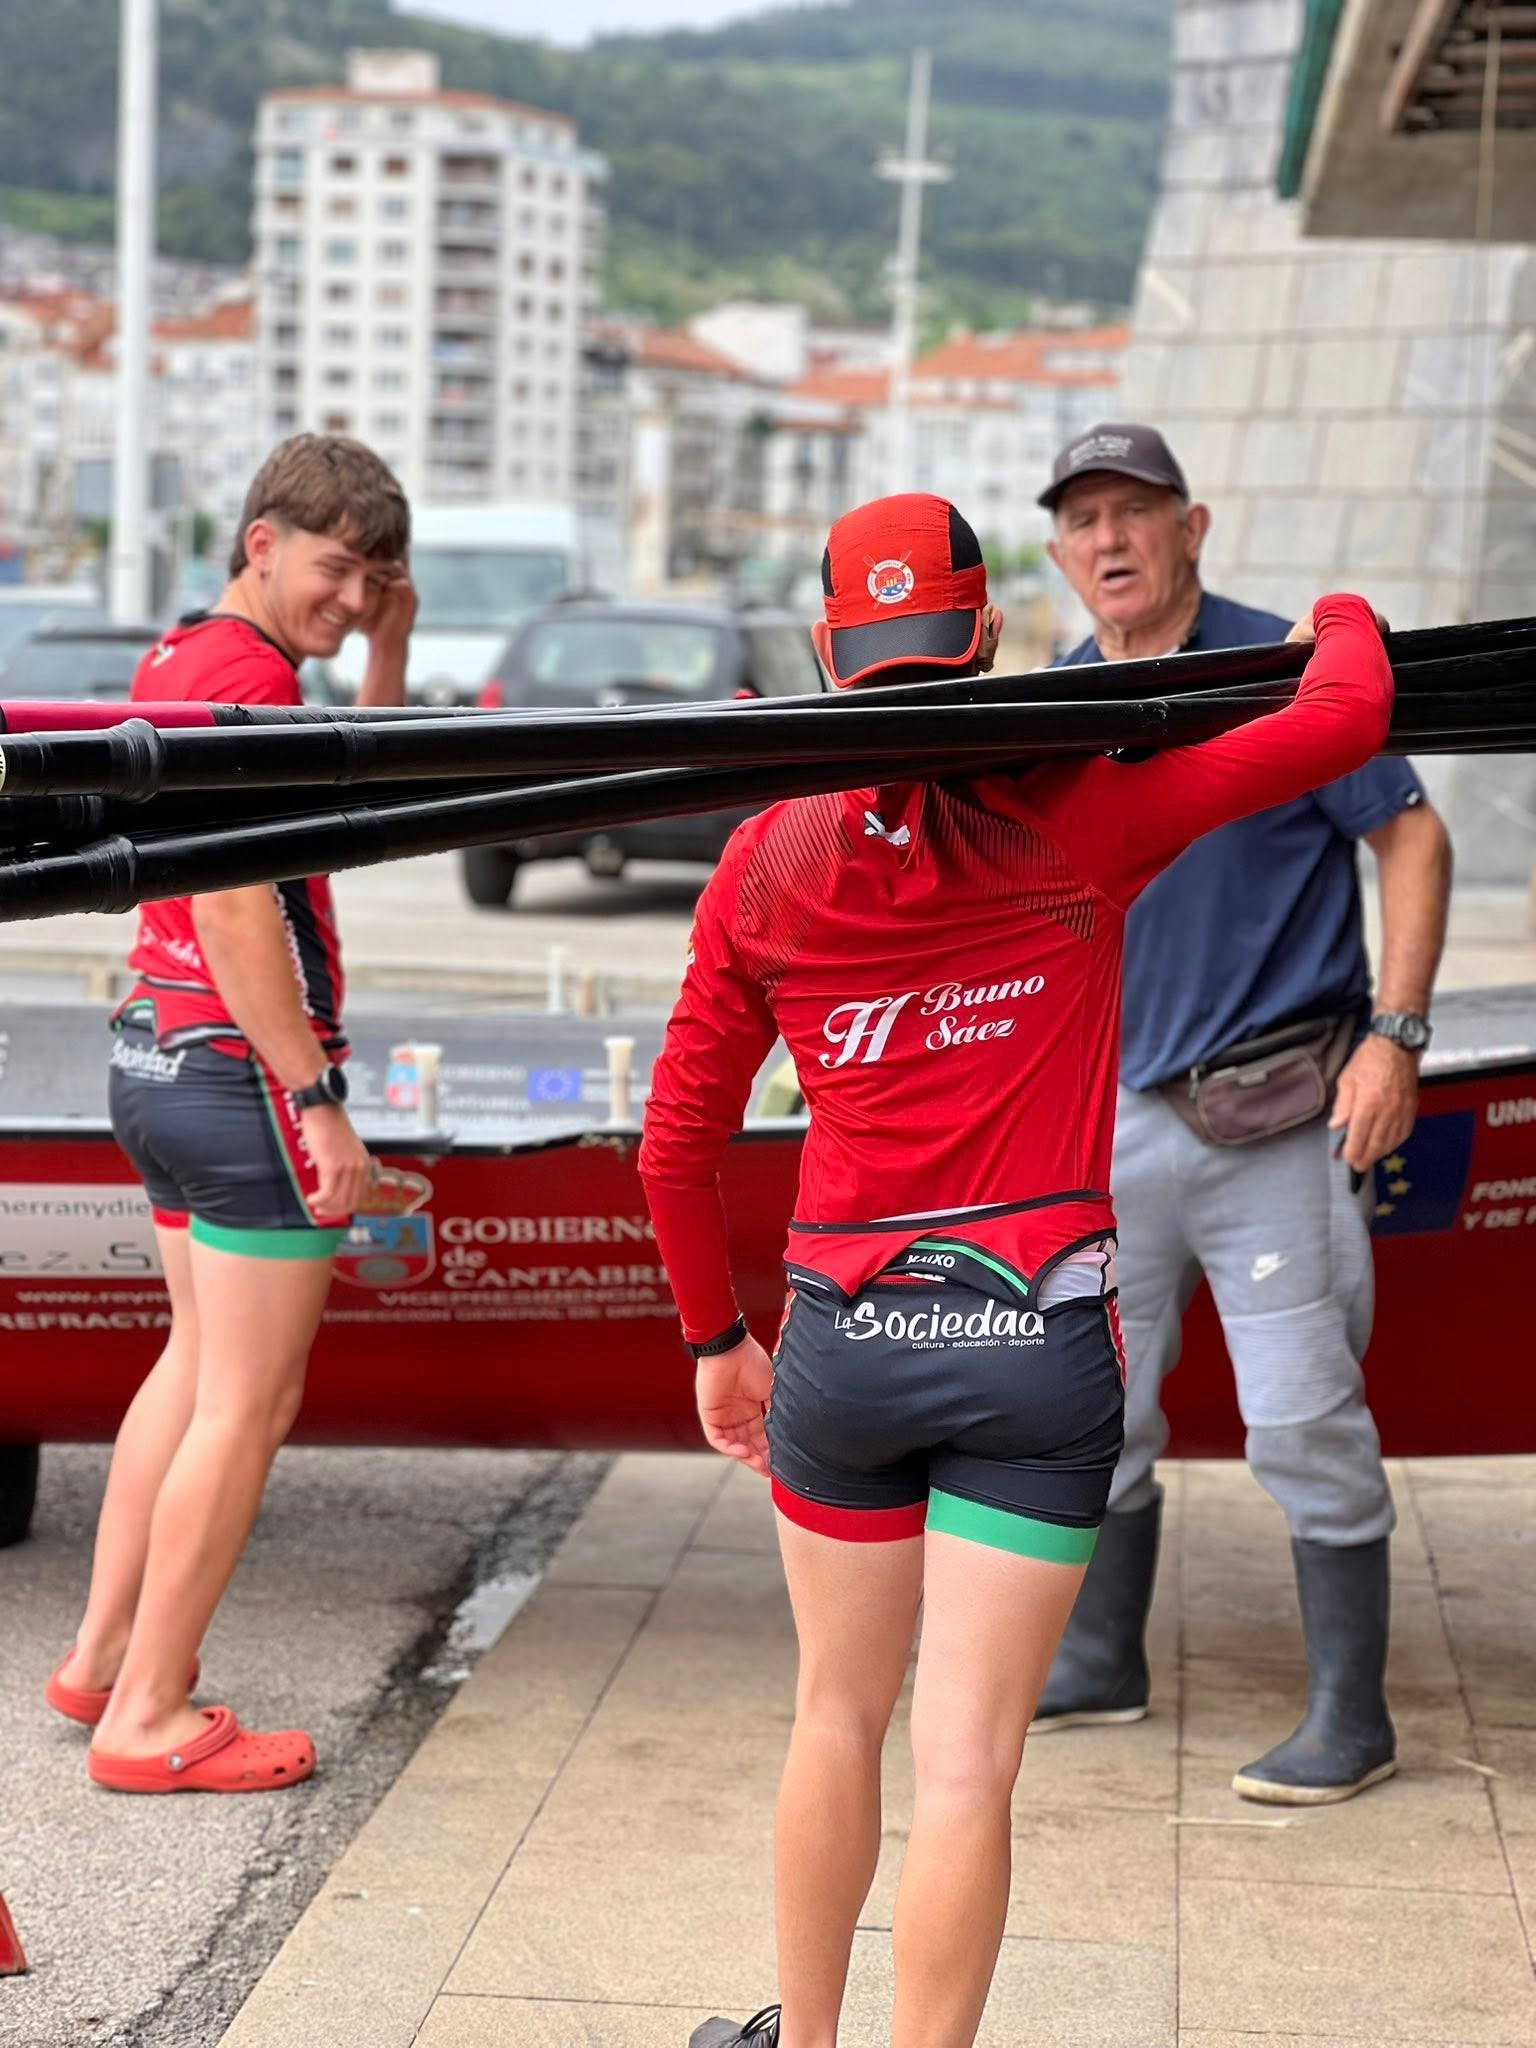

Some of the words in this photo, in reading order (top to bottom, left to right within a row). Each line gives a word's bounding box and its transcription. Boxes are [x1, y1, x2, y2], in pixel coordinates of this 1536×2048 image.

[920, 975, 1045, 1016] Bruno
[925, 1015, 1016, 1050] Sáez
[1486, 1097, 1536, 1127] UNI
[1484, 1207, 1525, 1229] DE
[441, 1246, 487, 1268] de
[834, 1311, 855, 1330] La
[911, 1340, 945, 1350] cultura
[952, 1338, 1000, 1349] educación
[1008, 1337, 1045, 1348] deporte
